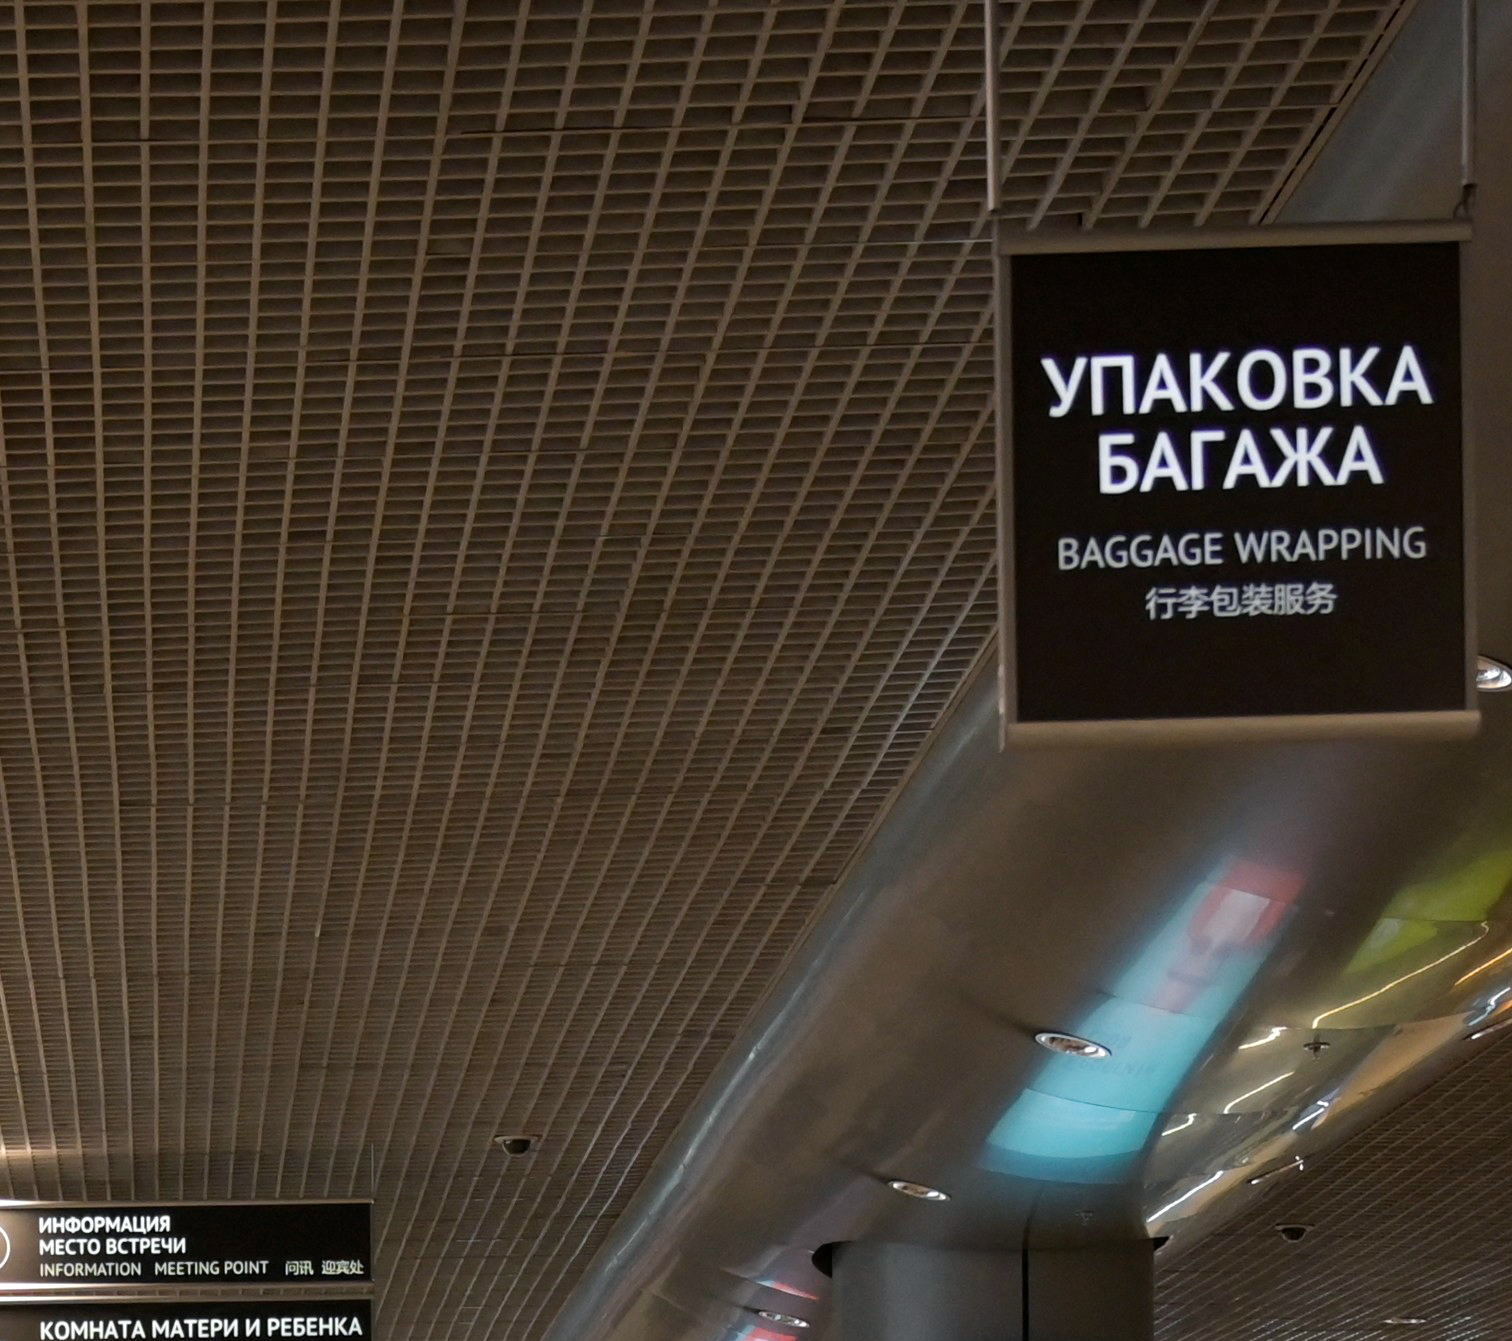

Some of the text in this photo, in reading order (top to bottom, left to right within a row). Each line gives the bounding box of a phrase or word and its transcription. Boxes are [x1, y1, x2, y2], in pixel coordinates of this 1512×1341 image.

[1041, 346, 1434, 417] УПАКОВКА
[1098, 426, 1384, 494] БАГАЖА
[1058, 528, 1428, 570] BAGGAGE WRAPPING
[1146, 582, 1337, 620] 行李包装服务
[39, 1217, 170, 1235] ИНФОРМАЦИЯ
[39, 1238, 186, 1255] МЕСТО ВСТРЕЧИ
[40, 1262, 141, 1277] INFORMATION
[155, 1261, 218, 1276] MEETING
[224, 1260, 268, 1275] POINT
[285, 1260, 313, 1275] 问讯
[40, 1317, 362, 1340] КОМНАТА МАТЕРИ И РЕБЕНКА
